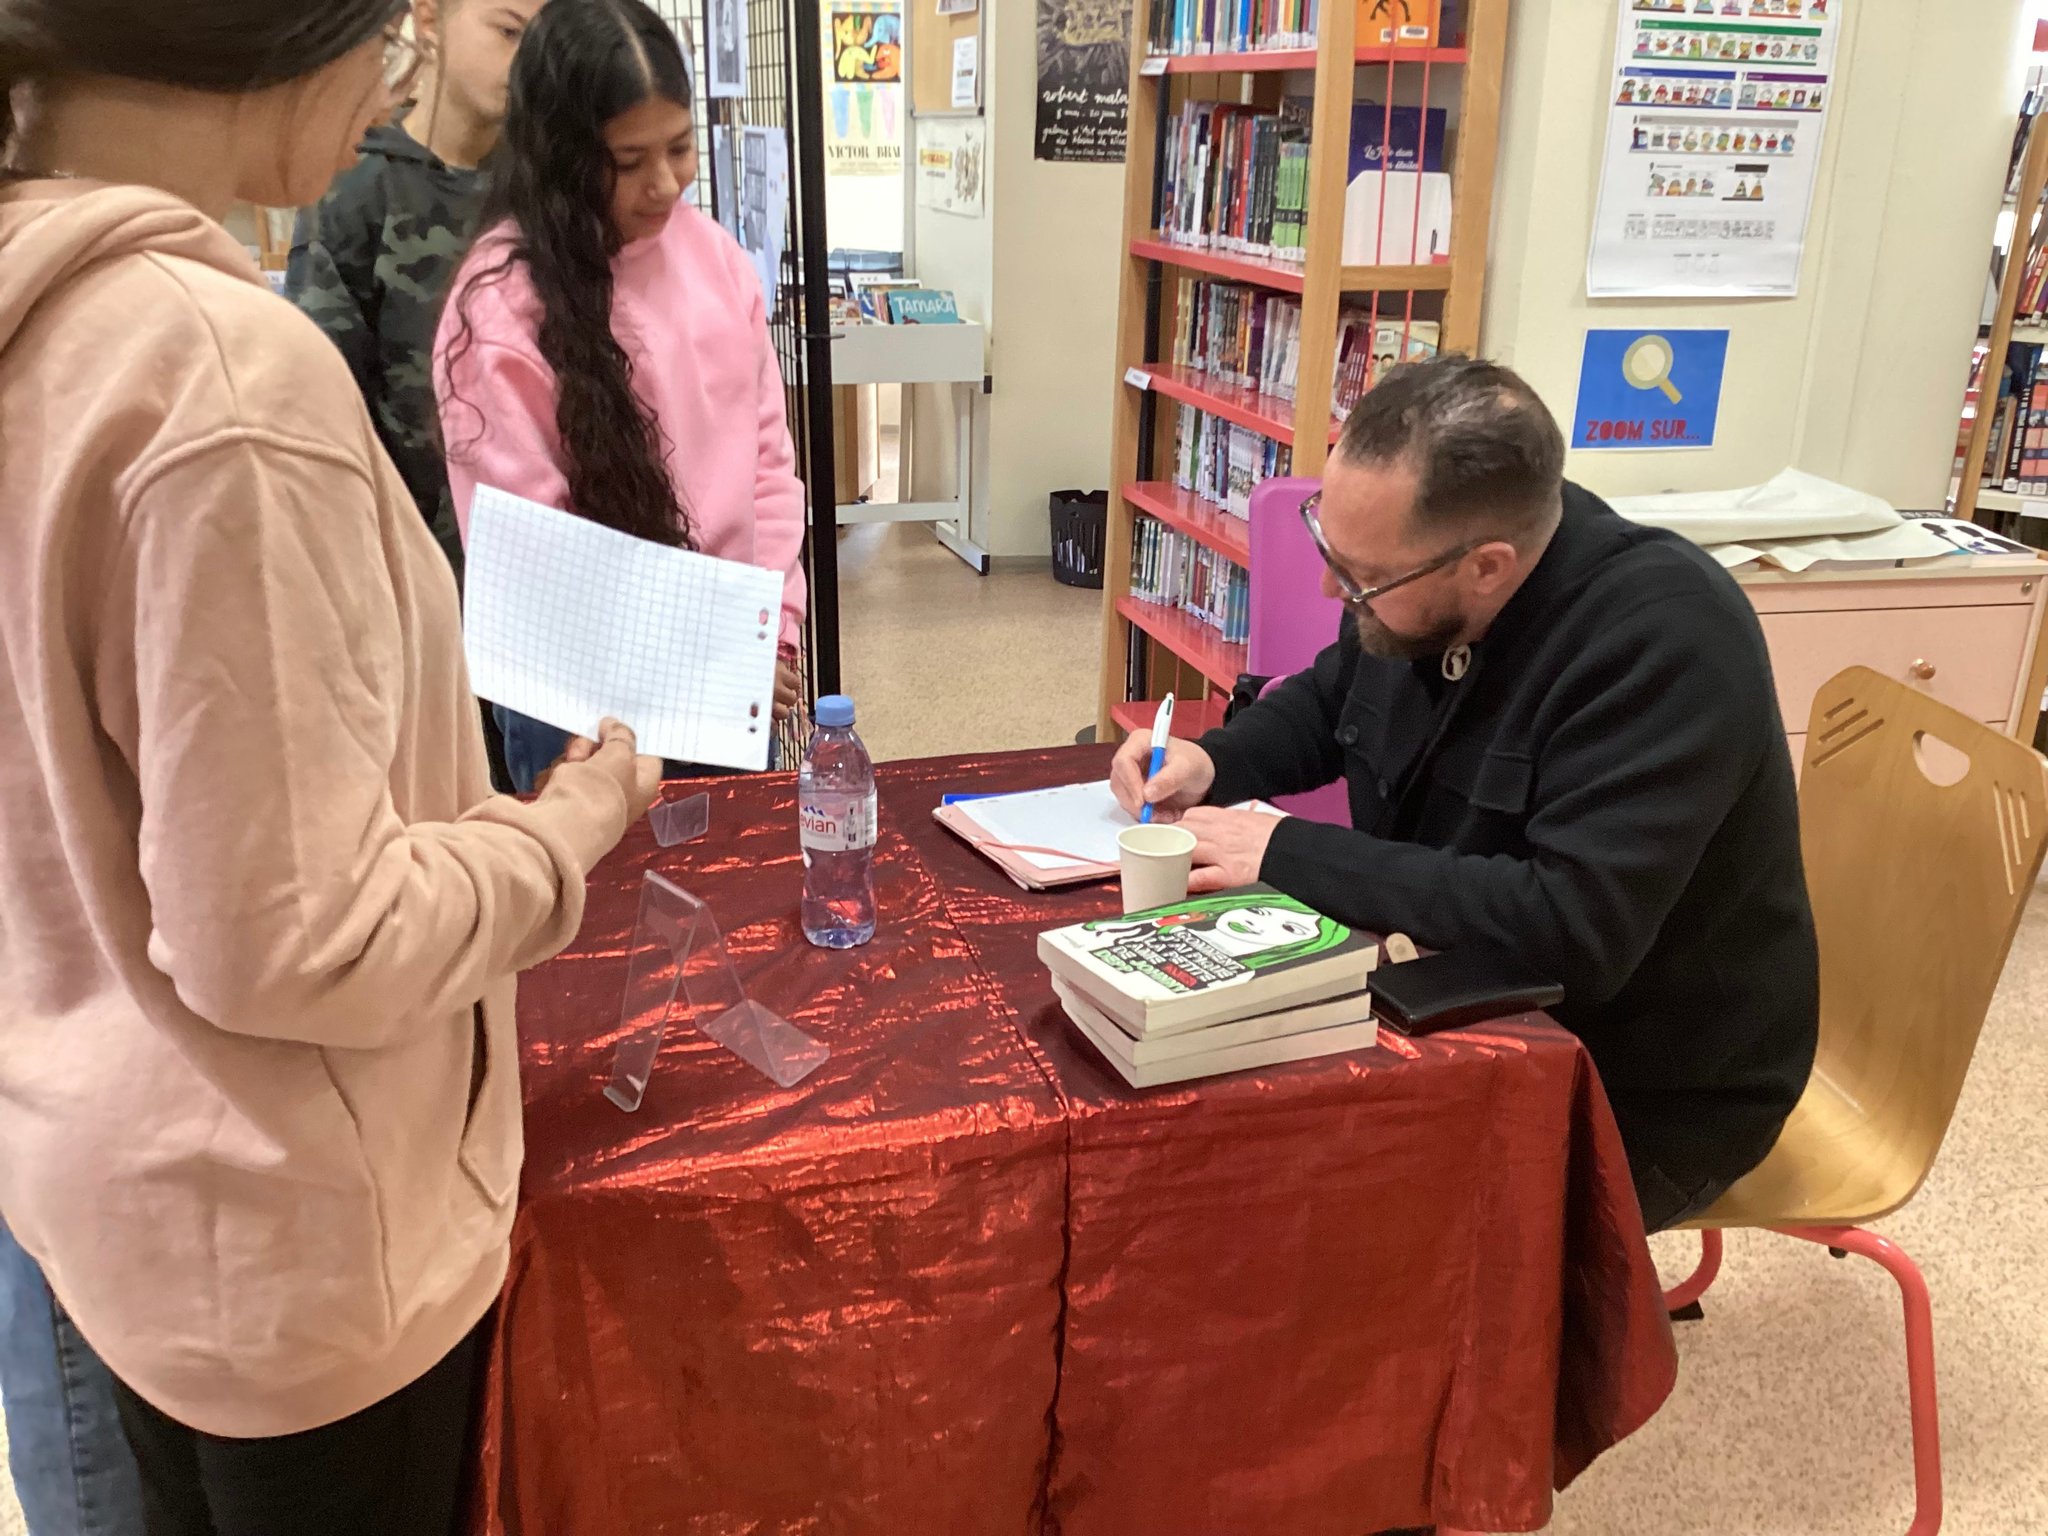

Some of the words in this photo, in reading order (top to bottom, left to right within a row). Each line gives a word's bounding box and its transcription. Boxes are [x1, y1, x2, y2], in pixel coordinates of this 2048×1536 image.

[1043, 86, 1089, 104] robert
[828, 145, 869, 159] VICTOR
[1586, 420, 1645, 442] ZOOM
[800, 813, 837, 834] evian
[1111, 945, 1138, 961] DE
[1143, 937, 1167, 953] LA
[1161, 949, 1217, 983] PETITE
[1175, 929, 1246, 970] COMMENT
[1092, 949, 1136, 974] DEPP
